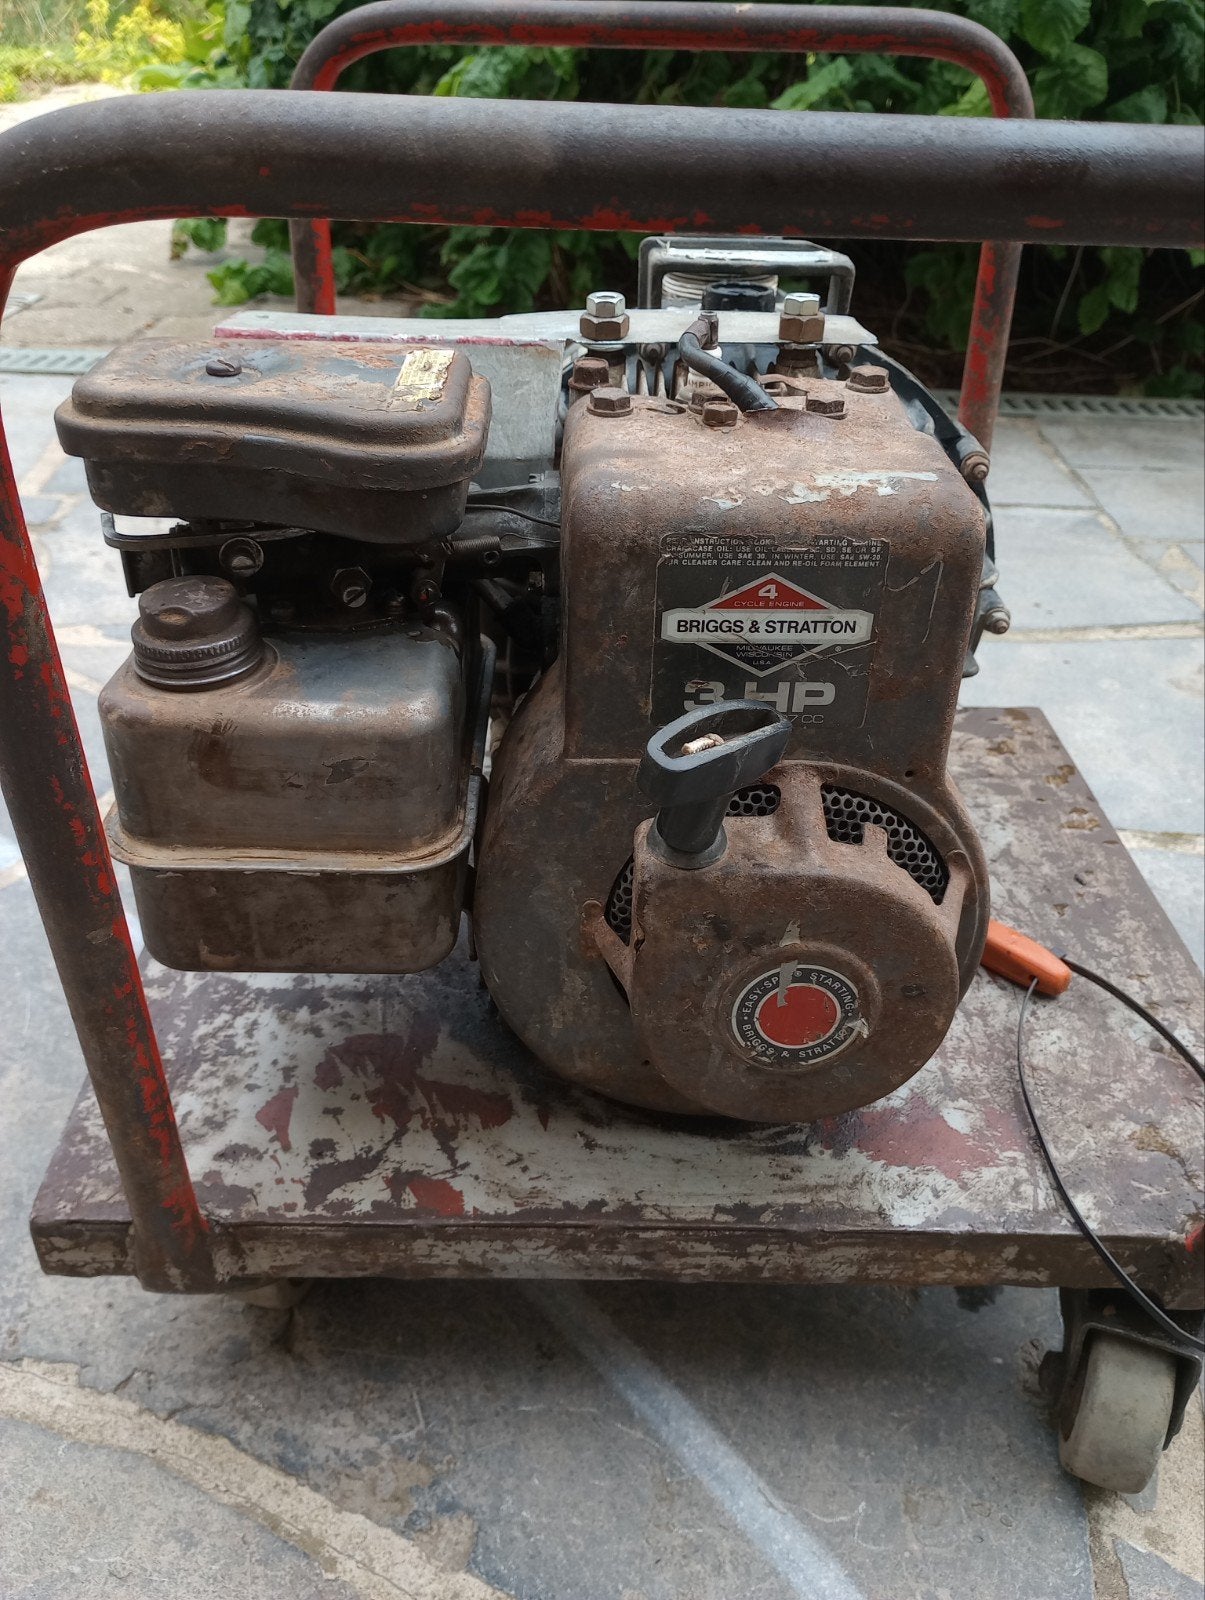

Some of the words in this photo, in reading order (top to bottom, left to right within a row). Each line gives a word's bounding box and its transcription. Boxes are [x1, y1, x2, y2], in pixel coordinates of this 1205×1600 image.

[746, 559, 773, 567] CLEAN
[773, 559, 790, 567] AND
[819, 560, 842, 568] FOAM
[758, 584, 778, 600] 4
[676, 619, 744, 634] BRIGGS
[748, 619, 761, 634] &
[764, 620, 857, 634] STRATTON
[683, 681, 725, 712] 3
[744, 681, 836, 713] HP
[801, 714, 825, 724] CC
[809, 971, 856, 1011] STARTING
[742, 1023, 775, 1056] BRIGGS
[780, 1050, 790, 1059] &
